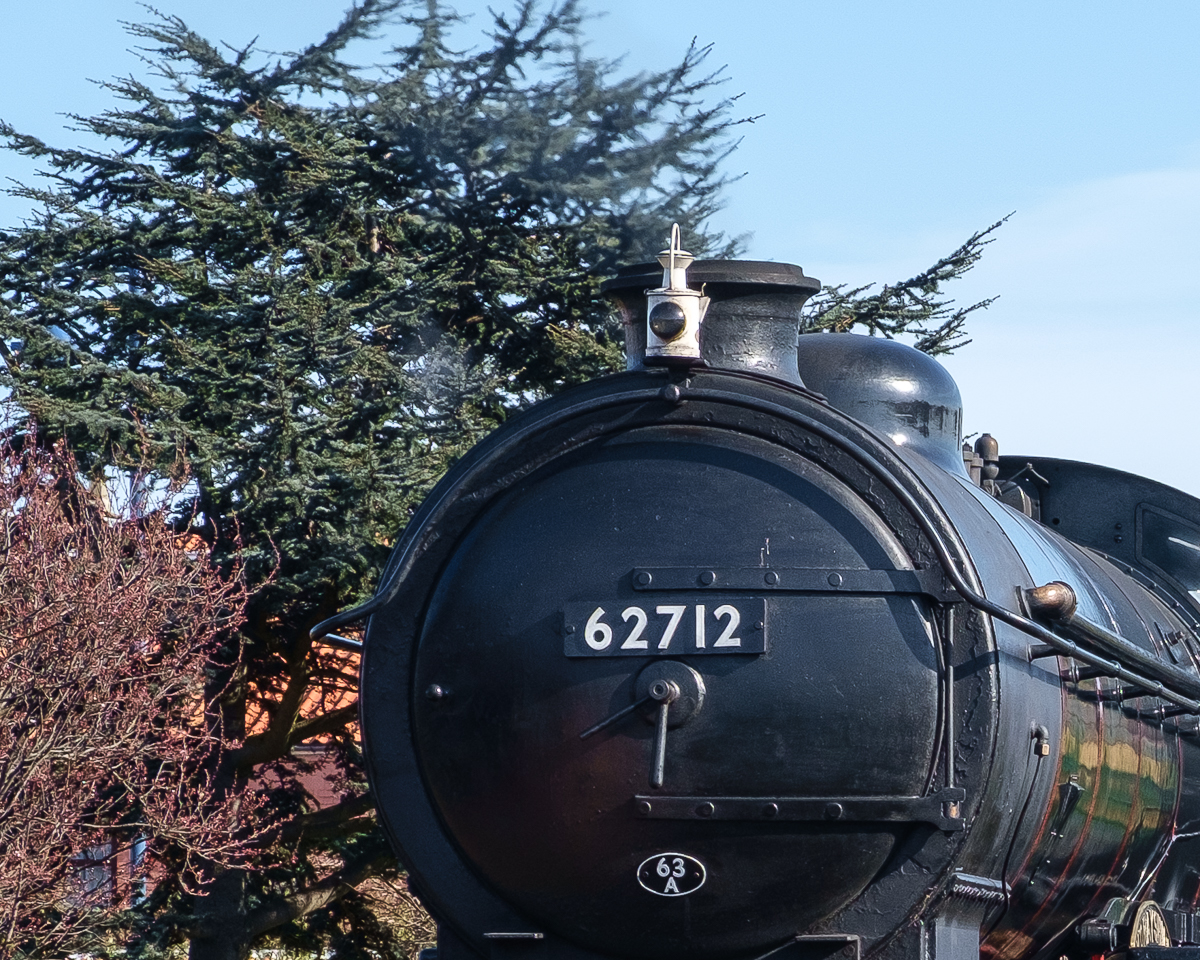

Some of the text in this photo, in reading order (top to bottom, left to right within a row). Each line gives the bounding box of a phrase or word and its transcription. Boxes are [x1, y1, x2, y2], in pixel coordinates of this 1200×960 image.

[584, 605, 742, 651] 62712
[656, 857, 686, 878] 63
[664, 877, 680, 893] A
